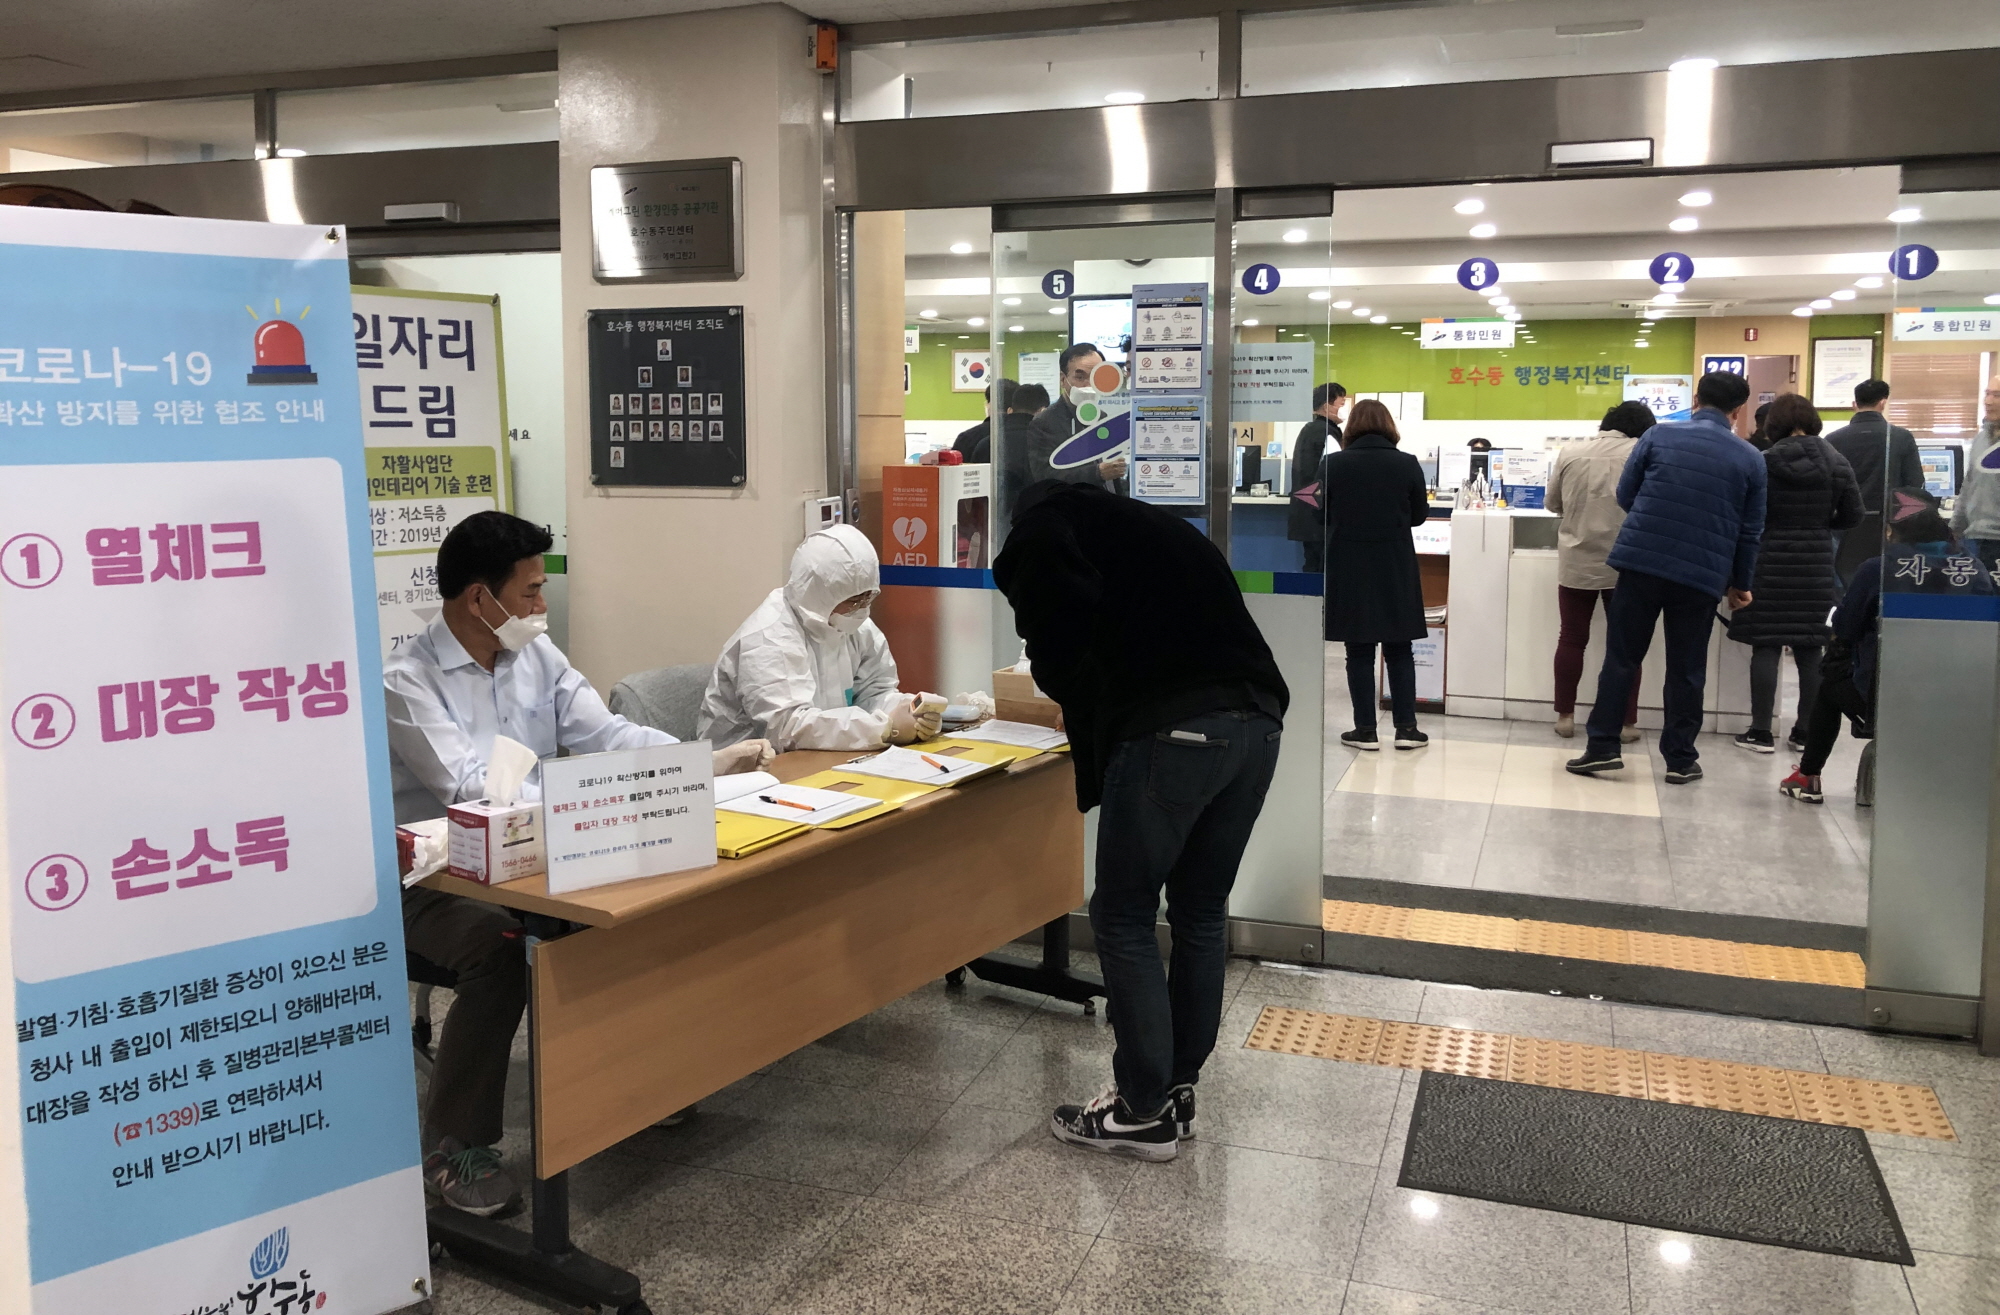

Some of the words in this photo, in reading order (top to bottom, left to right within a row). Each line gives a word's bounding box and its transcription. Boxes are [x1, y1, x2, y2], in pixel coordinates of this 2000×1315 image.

[630, 225, 694, 237] 호수동주민센터
[607, 320, 634, 332] 호수동
[637, 319, 692, 332] 행정복지센터
[696, 319, 725, 330] 조직도
[1452, 329, 1502, 341] 통합민원
[1932, 319, 1991, 332] 통합민원
[352, 313, 475, 371] 일자리
[1447, 366, 1504, 386] 호수동
[1514, 364, 1631, 386] 행정복지센터
[56, 399, 142, 427] 방지를
[152, 399, 205, 426] 위한
[214, 399, 267, 425] 협조
[275, 398, 326, 424] 안내
[369, 385, 456, 438] 드림
[381, 455, 453, 474] 자활사업단
[434, 475, 461, 494] 기술
[465, 474, 492, 493] 훈련
[398, 505, 447, 523] 저소득층
[399, 526, 442, 543] 2019년
[86, 521, 266, 586] 열체크
[892, 552, 928, 567] AED
[1895, 554, 2000, 587] 자동
[98, 674, 220, 743] 대장
[236, 661, 349, 722] 작성
[578, 775, 613, 788] 코로나19
[659, 766, 682, 777] 위하여
[552, 801, 577, 813] 열체크
[656, 786, 679, 797] 주시기
[622, 813, 638, 823] 작성
[641, 806, 690, 820] 부탁드립니다.
[111, 816, 290, 901] 손소독
[501, 854, 537, 868] 1566-0466
[226, 962, 284, 994] 증상이
[291, 949, 346, 980] 있으신
[352, 941, 388, 966] 분은
[30, 1051, 73, 1082] 청사
[82, 1044, 102, 1067] 내
[110, 1028, 172, 1063] 출입이
[180, 1003, 277, 1043] 제한되오니
[284, 981, 382, 1020] 양해바라며,
[26, 1090, 91, 1124] 대장을
[98, 1077, 140, 1105] 작성
[148, 1064, 189, 1093] 하신
[196, 1058, 216, 1081] 후
[224, 1015, 390, 1075] 질병관리본부콜센터
[227, 1070, 323, 1114] 연락하셔서
[112, 1156, 154, 1188] 안내
[161, 1132, 241, 1174] 받으시기
[249, 1109, 330, 1147] 바랍니다.
